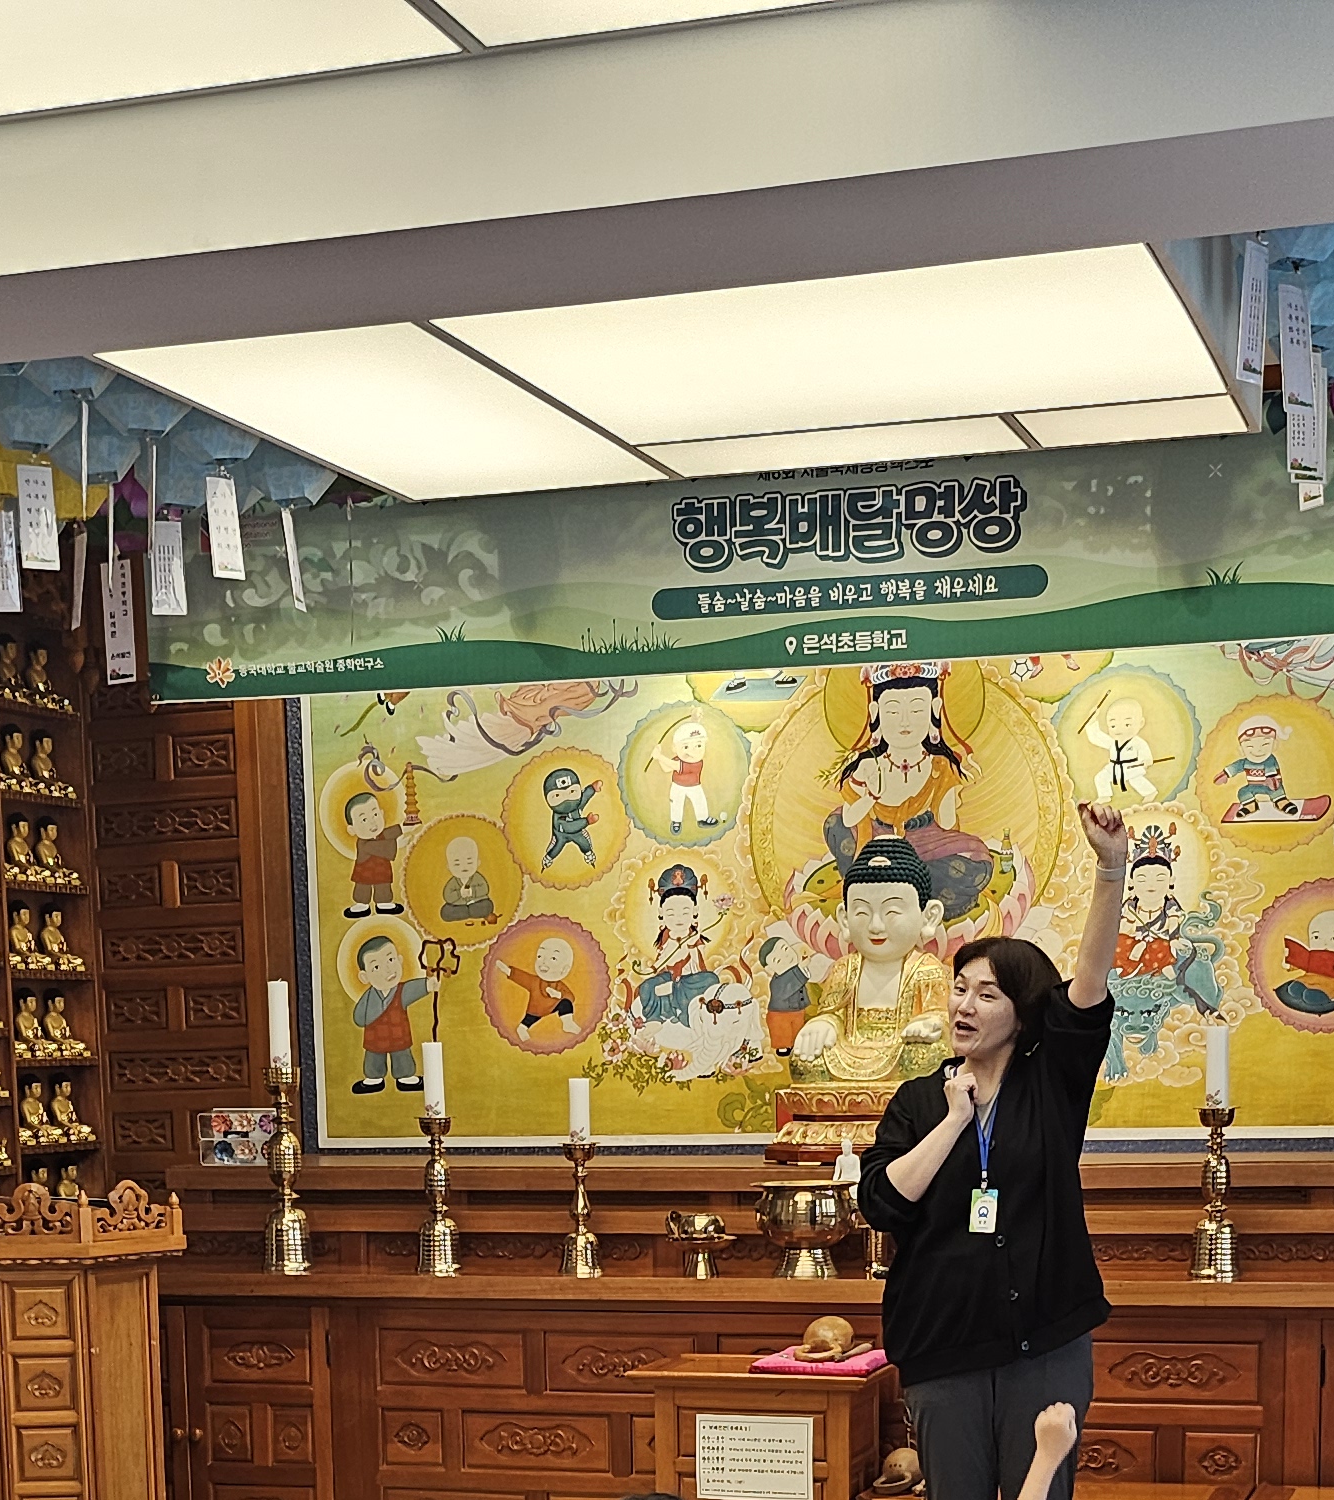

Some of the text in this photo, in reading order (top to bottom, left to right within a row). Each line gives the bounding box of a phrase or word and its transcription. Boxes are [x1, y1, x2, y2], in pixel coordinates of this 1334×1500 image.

[672, 475, 1027, 572] 행복배달명상
[828, 584, 874, 604] 비우고
[879, 578, 927, 600] 행복을
[934, 573, 999, 597] 채우세요
[802, 629, 908, 656] 은석초등학교
